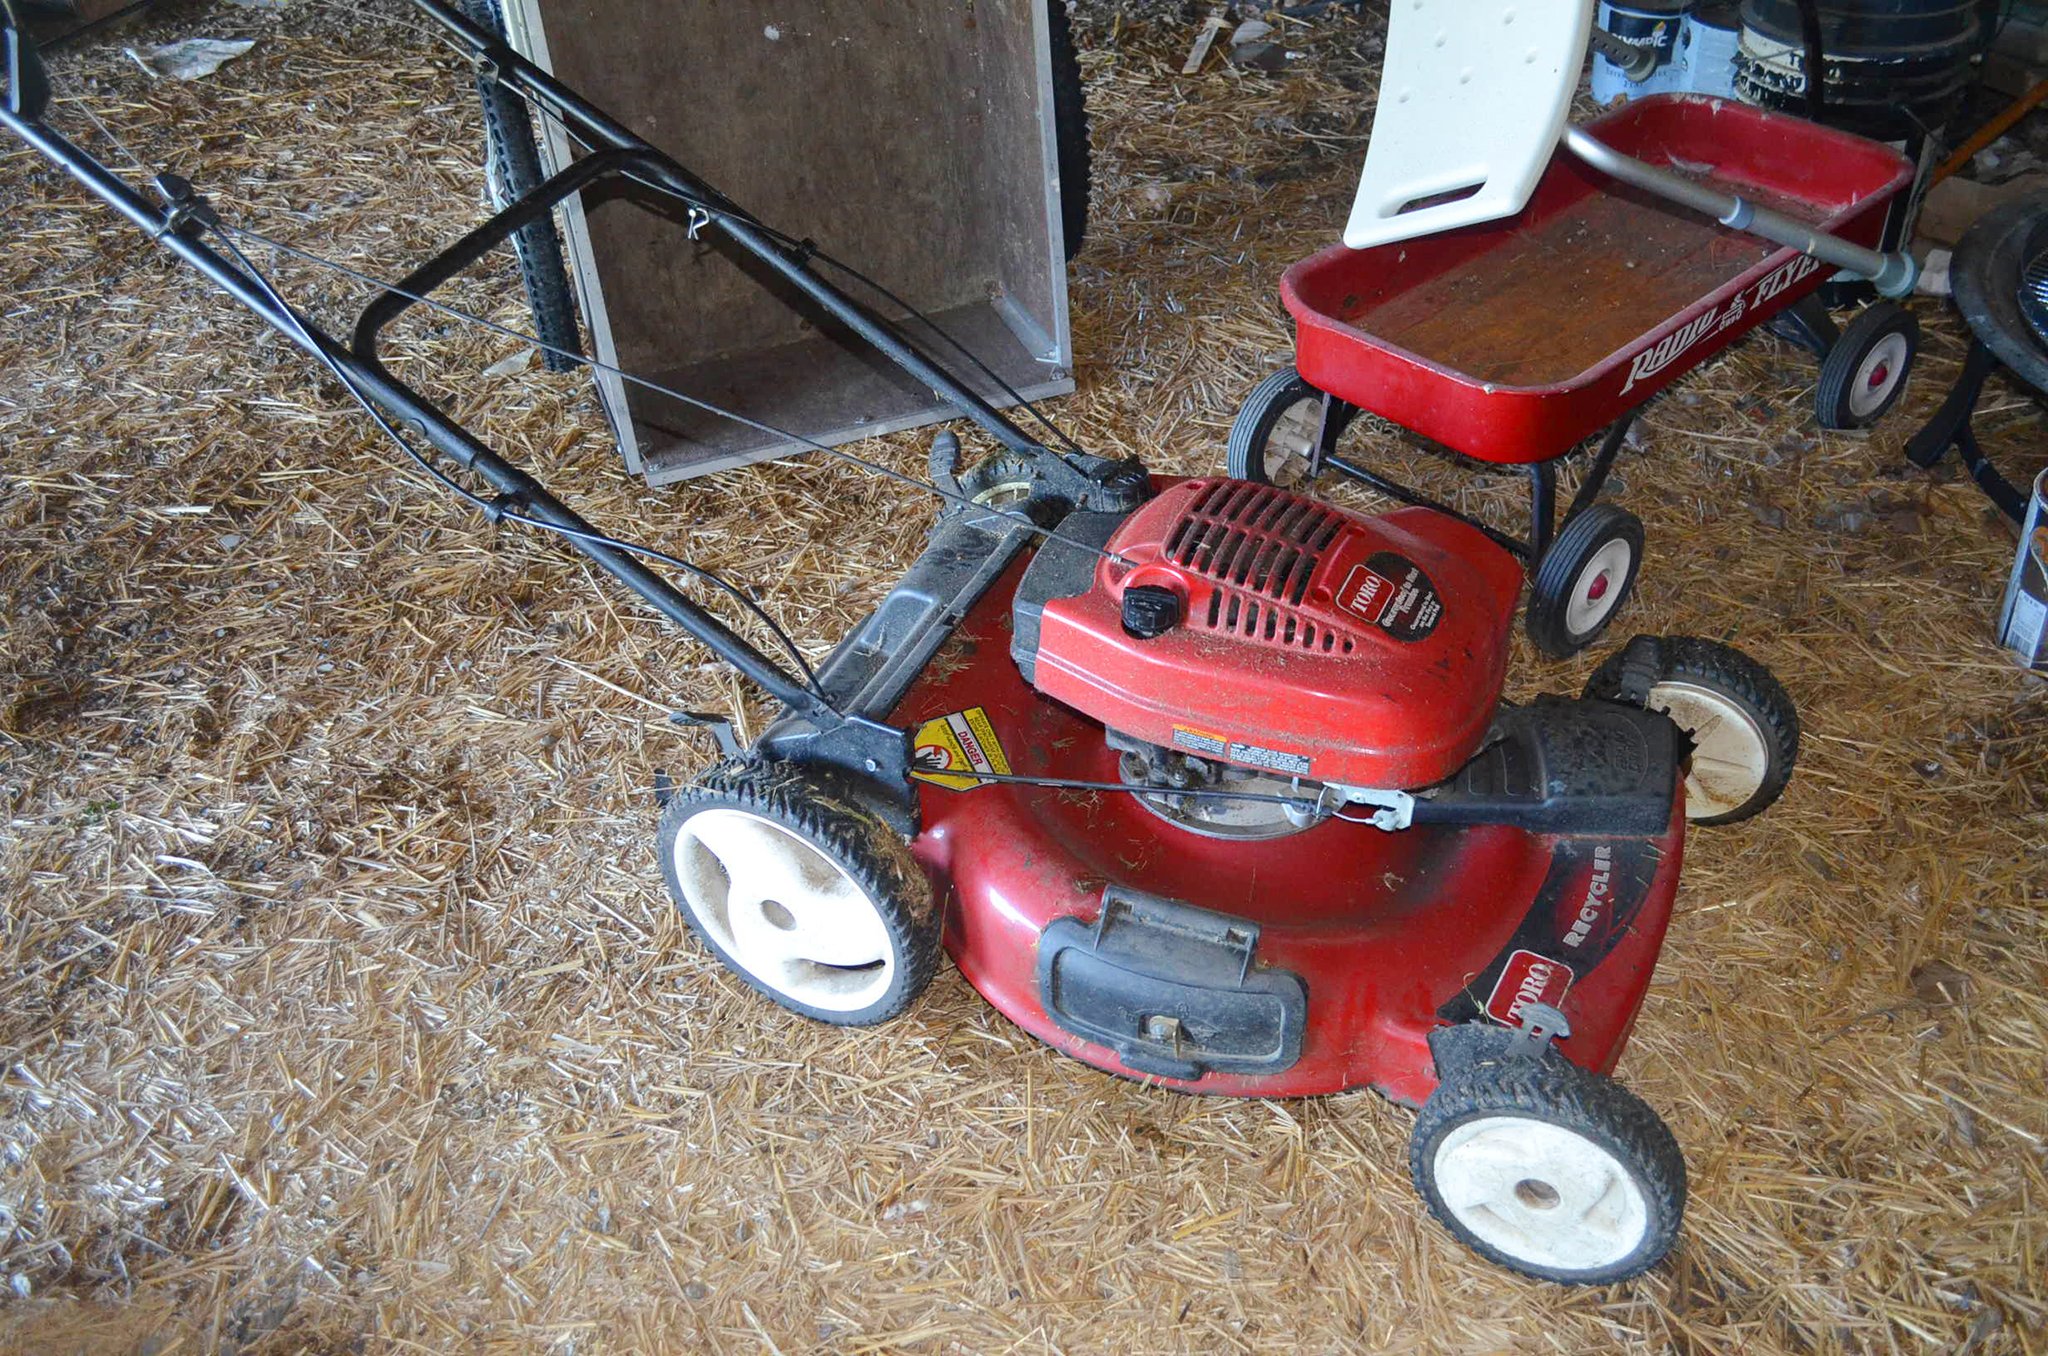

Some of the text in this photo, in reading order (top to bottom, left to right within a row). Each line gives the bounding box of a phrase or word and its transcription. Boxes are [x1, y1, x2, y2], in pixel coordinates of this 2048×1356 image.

[1619, 307, 1719, 397] RADIO
[1350, 575, 1381, 613] TORO
[958, 731, 983, 765] DANGER
[1563, 846, 1611, 948] RECYCLER
